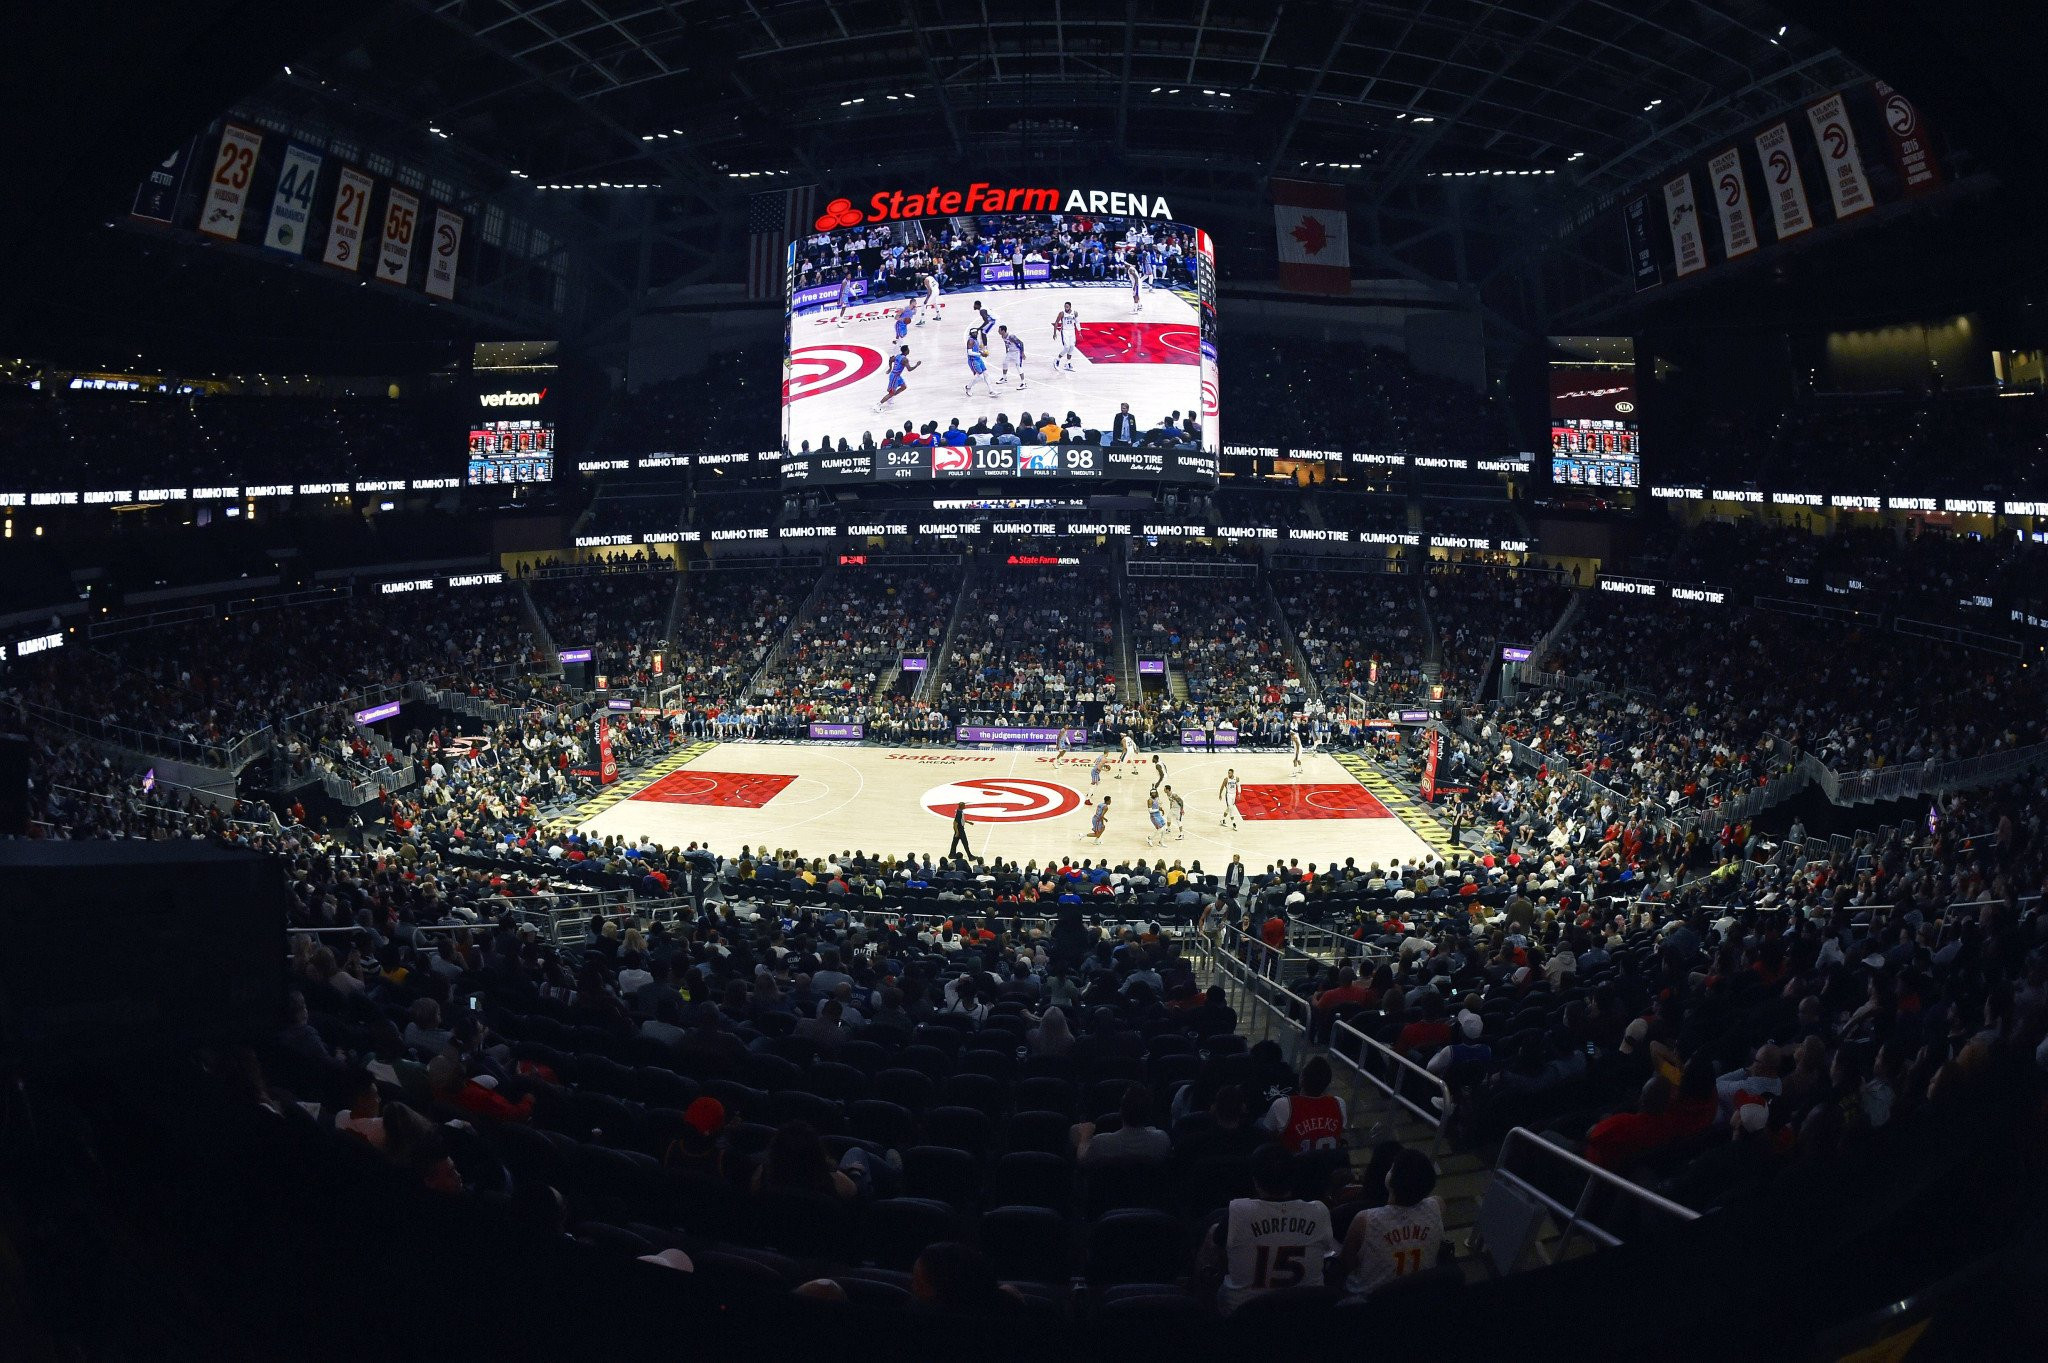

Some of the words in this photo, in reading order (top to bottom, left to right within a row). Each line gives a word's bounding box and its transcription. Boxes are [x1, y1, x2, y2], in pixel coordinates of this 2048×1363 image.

[215, 143, 253, 189] 23
[279, 164, 314, 210] 44
[336, 184, 366, 226] 21
[1064, 190, 1172, 220] ARENA
[386, 204, 414, 244] 55
[480, 390, 540, 407] verizon
[1224, 447, 1258, 456] KUMHO
[1259, 448, 1278, 457] TIRE
[1290, 450, 1322, 459] KUMHO
[1324, 452, 1342, 460] TIRE
[639, 458, 671, 467] KUMHO
[671, 457, 689, 466] TIRE
[699, 454, 730, 464] KUMHO
[731, 453, 748, 462] TIRE
[822, 459, 852, 468] KUMHO
[852, 458, 870, 466] TIRE
[888, 452, 919, 464] 9:42
[976, 450, 1013, 469] 105
[1066, 450, 1094, 468] 98
[1109, 454, 1142, 463] KUMHO
[1144, 455, 1162, 464] TIRE
[1353, 454, 1385, 463] KUMHO
[1386, 456, 1405, 465] TIRE
[1415, 458, 1448, 467] KUMHO
[1448, 460, 1467, 468] TIRE
[579, 461, 610, 470] KUMHO
[611, 460, 629, 468] TIRE
[1478, 462, 1510, 471] KUMHO
[1510, 464, 1529, 472] TIRE
[300, 484, 331, 494] KUMHO
[331, 483, 349, 492] TIRE
[356, 482, 387, 491] KUMHO
[387, 481, 405, 490] TIRE
[413, 479, 444, 488] KUMHO
[1652, 488, 1684, 498] KUMHO
[1684, 489, 1703, 498] TIRE
[1713, 490, 1745, 501] KUMHO
[1745, 492, 1764, 502] TIRE
[1773, 493, 1804, 504] KUMHO
[1805, 495, 1823, 505] TIRE
[1832, 496, 1863, 506] KUMHO
[1863, 497, 1880, 508] TIRE
[1889, 498, 1919, 509] KUMHO
[1919, 499, 1936, 510] TIRE
[1945, 500, 1977, 512] KUMHO
[1977, 501, 1996, 512] TIRE
[712, 530, 746, 540] KUMHO
[748, 529, 768, 538] TIRE
[780, 527, 815, 537] KUMHO
[816, 527, 836, 536] TIRE
[848, 525, 884, 535] KUMHO
[886, 525, 907, 534] TIRE
[920, 524, 957, 534] KUMHO
[958, 524, 980, 533] TIRE
[994, 524, 1032, 534] KUMHO
[1032, 524, 1055, 533] TIRE
[1068, 524, 1107, 534] KUMHO
[1108, 525, 1130, 534] TIRE
[1144, 525, 1182, 535] KUMHO
[1183, 526, 1205, 536] TIRE
[1218, 527, 1255, 537] KUMHO
[1256, 528, 1278, 538] TIRE
[576, 536, 612, 546] KUMHO
[612, 535, 632, 544] TIRE
[644, 533, 679, 543] KUMHO
[680, 532, 700, 541] TIRE
[1290, 529, 1326, 540] KUMHO
[1327, 531, 1348, 541] TIRE
[1360, 533, 1397, 543] KUMHO
[1398, 535, 1419, 545] TIRE
[1431, 537, 1467, 547] KUMHO
[1468, 539, 1489, 549] TIRE
[450, 577, 482, 586] KUMHO
[483, 576, 502, 584] TIRE
[382, 584, 414, 594] KUMHO
[415, 582, 433, 590] TIRE
[1602, 582, 1635, 592] KUMHO
[1636, 584, 1655, 594] TIRE
[1672, 588, 1704, 600] KUMHO
[992, 732, 1028, 740] judgement
[1296, 1116, 1339, 1136] CHEEKS
[1250, 1217, 1316, 1237] HORFORD
[1384, 1226, 1430, 1246] YOUNG
[1249, 1245, 1306, 1289] 15
[1393, 1248, 1424, 1276] 11
